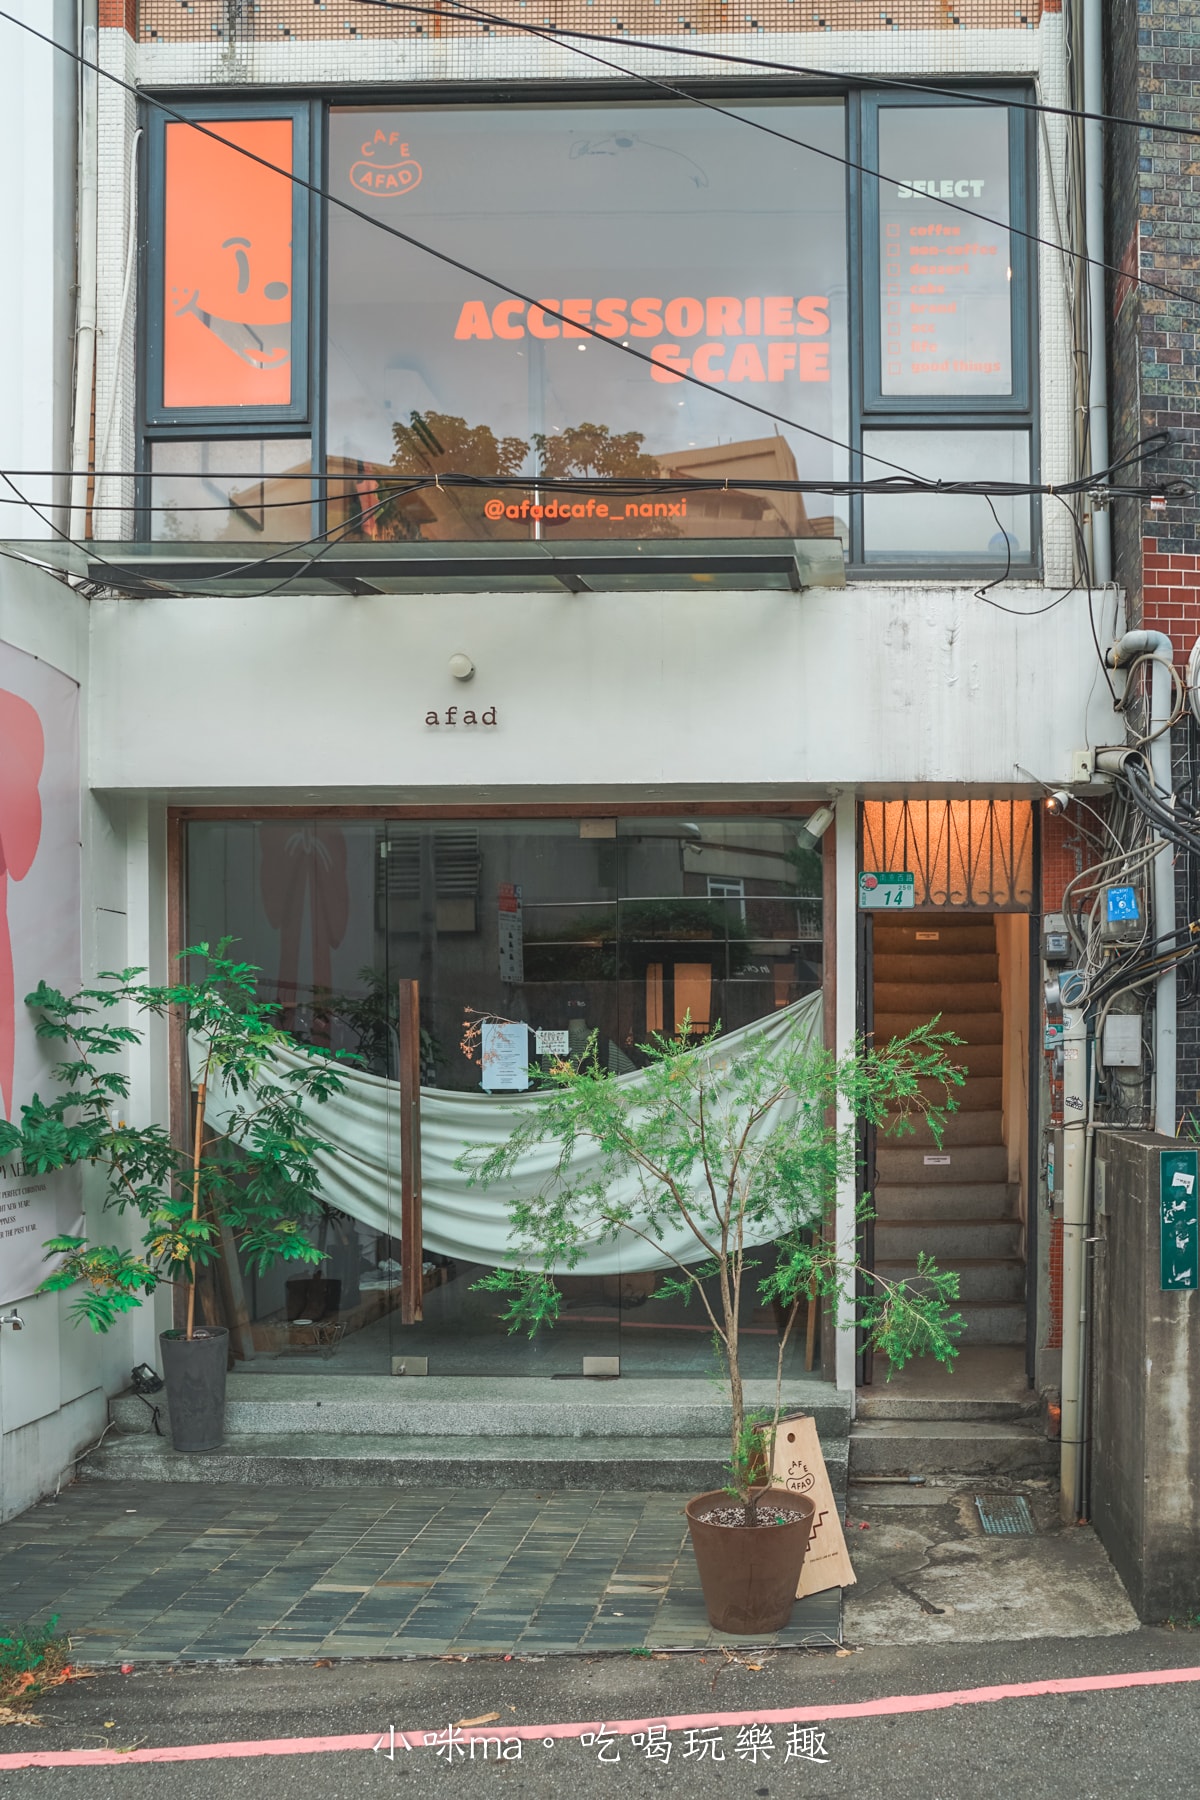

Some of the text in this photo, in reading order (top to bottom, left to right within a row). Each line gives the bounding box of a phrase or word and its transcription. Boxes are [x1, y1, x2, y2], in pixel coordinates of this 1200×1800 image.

[361, 129, 411, 158] CAFE
[360, 169, 412, 189] AFAD
[897, 179, 985, 199] SELECT
[909, 223, 961, 237] coffee
[909, 242, 998, 256] non-coffee
[909, 262, 970, 275] dessert
[910, 301, 957, 314] brand
[454, 296, 830, 340] ACCESSORIES
[911, 323, 936, 334] acc
[911, 340, 938, 353] life
[649, 342, 831, 384] &CAFE
[911, 359, 1001, 374] good things
[484, 498, 687, 521] @afadcafe_nanxi
[424, 705, 498, 726] afad
[884, 890, 904, 906] 14
[788, 1460, 809, 1476] CAFE
[790, 1478, 812, 1490] AFAD
